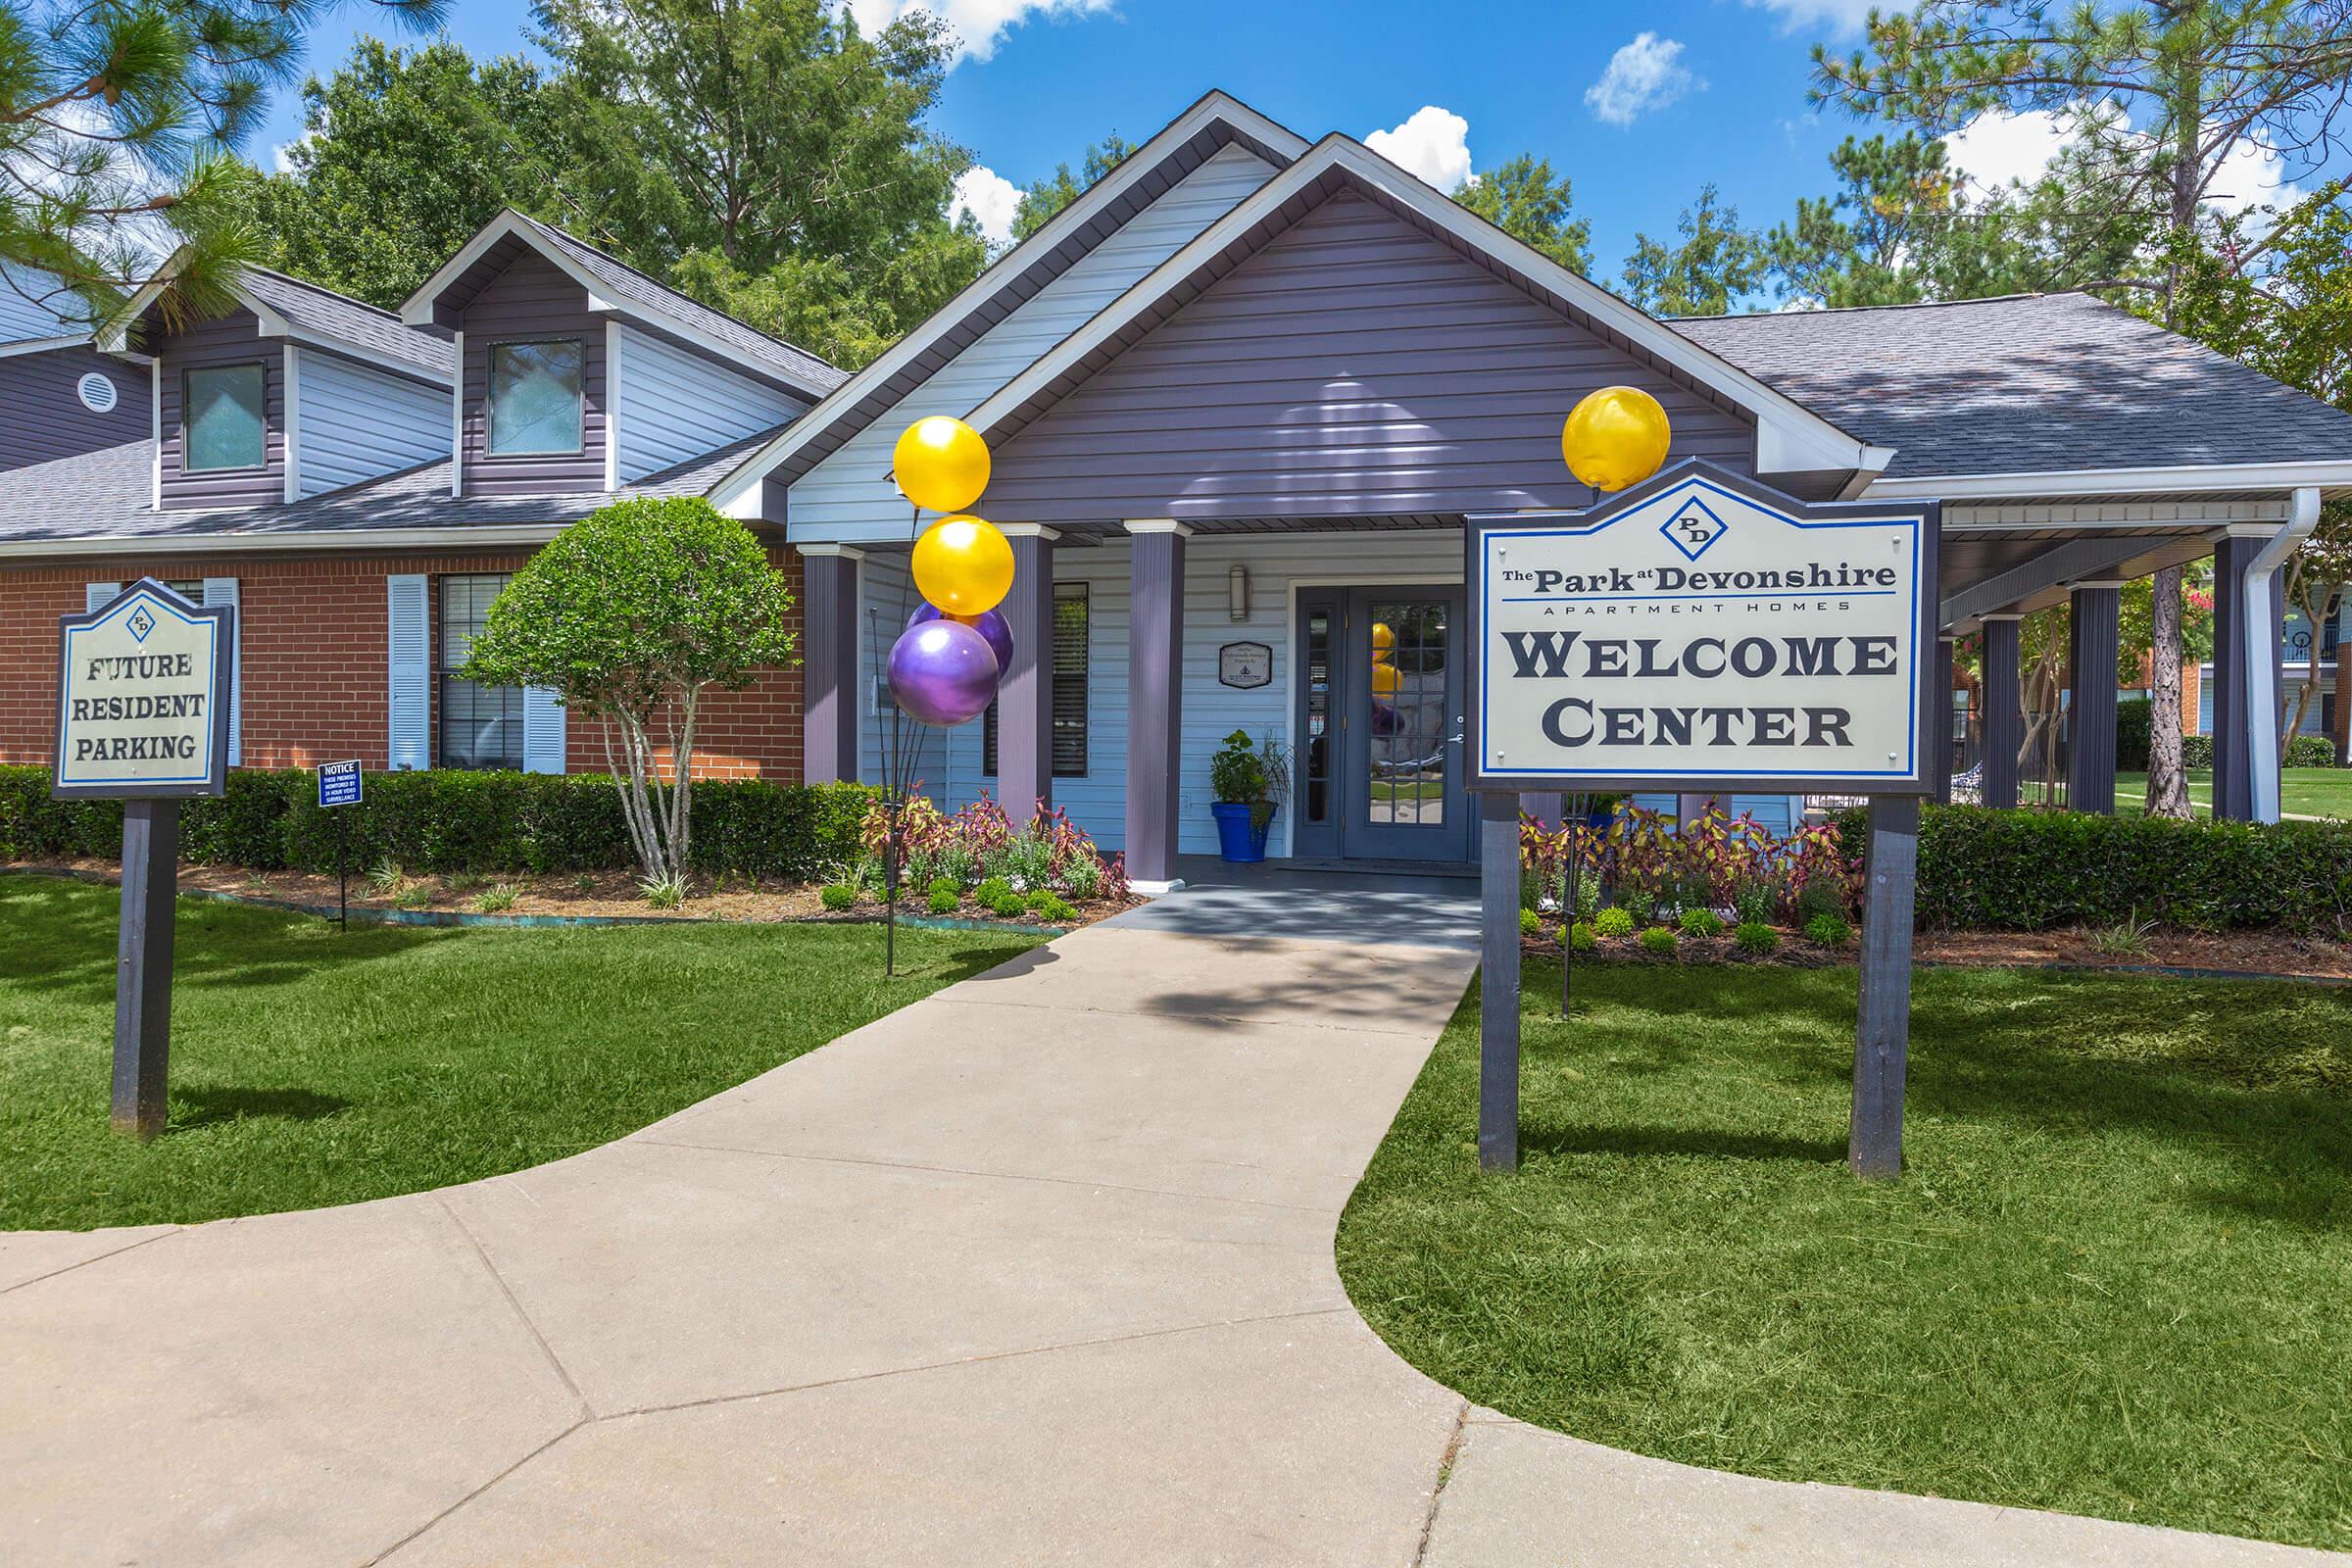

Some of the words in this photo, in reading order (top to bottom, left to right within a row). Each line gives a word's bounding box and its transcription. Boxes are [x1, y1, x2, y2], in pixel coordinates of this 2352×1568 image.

[1502, 569, 1534, 582] The
[1534, 567, 1636, 593] Park
[1637, 567, 1653, 580] at
[1654, 562, 1896, 591] Devonshire
[1544, 604, 1724, 615] APARTMENT
[1747, 601, 1850, 612] HOMES
[87, 654, 192, 680] FUTURE
[1500, 630, 1897, 679] WELCOME
[72, 694, 205, 721] RESIDENT
[1541, 697, 1855, 748] CENTER
[75, 735, 196, 761] PARKING
[325, 763, 354, 775] NOTICE
[326, 794, 355, 803] SURVEILLANCE
